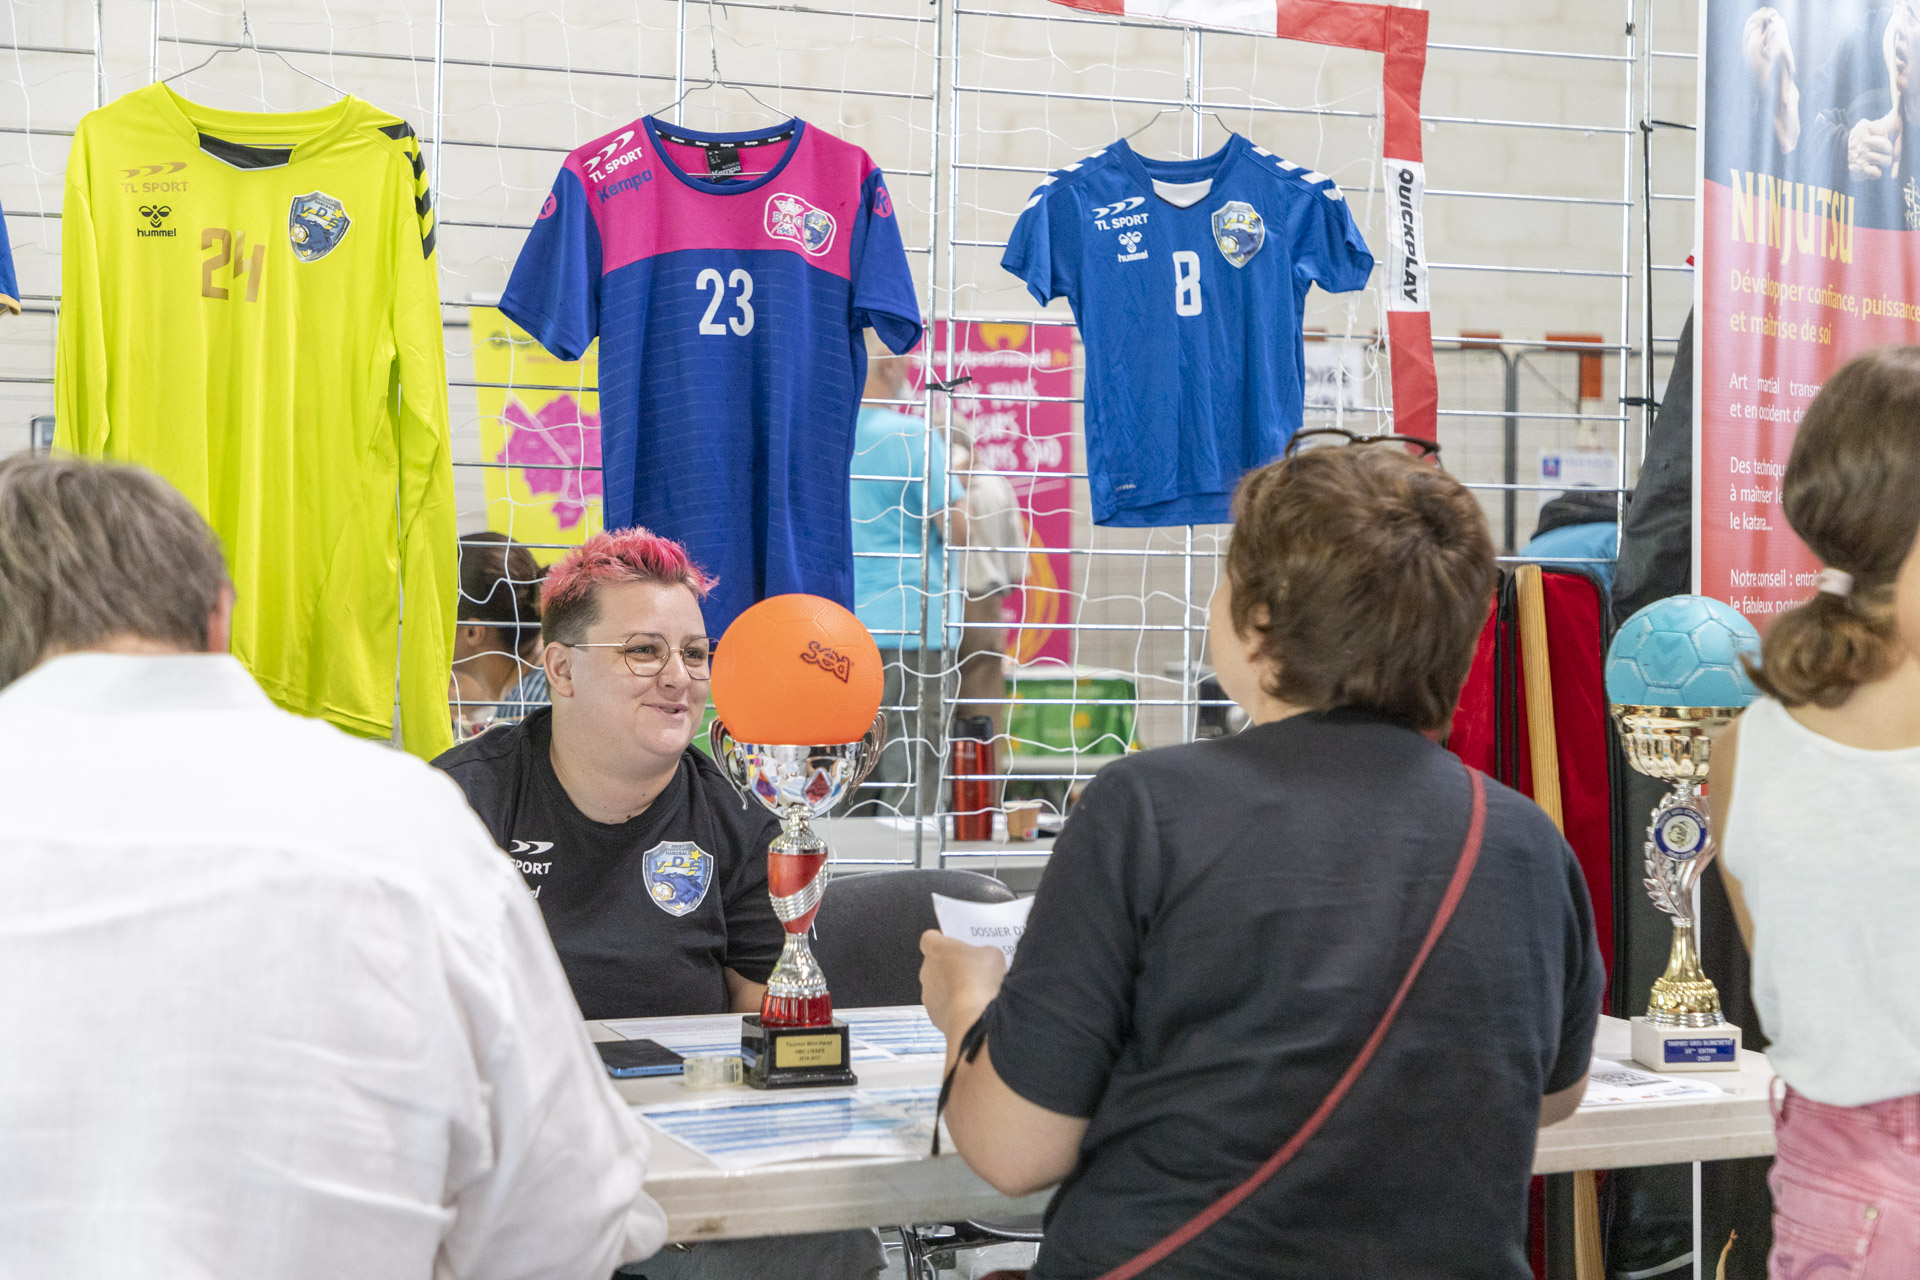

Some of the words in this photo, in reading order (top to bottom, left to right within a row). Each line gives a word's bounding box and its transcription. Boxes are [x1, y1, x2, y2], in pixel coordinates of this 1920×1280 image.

[588, 170, 606, 183] TL
[605, 146, 643, 174] SPORT
[121, 183, 139, 193] TL
[142, 181, 189, 192] SPORT
[597, 169, 653, 204] Kempa
[1094, 219, 1111, 231] TL
[1111, 213, 1149, 229] SPORT
[1730, 168, 1854, 265] NINJUTSU
[136, 228, 177, 237] hummel
[1398, 168, 1418, 304] QUICKPLAY
[201, 227, 266, 303] 24
[1117, 249, 1149, 263] hummel
[1172, 250, 1202, 317] 8
[695, 268, 755, 337] 23
[1730, 268, 1804, 307] Développer
[1807, 283, 1859, 318] confiance,
[1862, 293, 1920, 322] puissance
[1729, 311, 1746, 333] et
[1750, 312, 1798, 341] maîtrise
[1801, 318, 1817, 343] de
[1818, 323, 1832, 345] soi
[1729, 372, 1748, 390] Art
[1730, 402, 1742, 418] et
[1744, 404, 1757, 420] en
[1759, 404, 1790, 423] occident
[1730, 456, 1751, 474] Des
[1729, 483, 1737, 502] à
[1740, 484, 1773, 504] maîtriser
[1730, 511, 1740, 530] le
[1730, 569, 1756, 587] Notre
[1757, 568, 1786, 587] conseil
[1730, 596, 1740, 612] le
[970, 926, 1011, 937] DOSSIER
